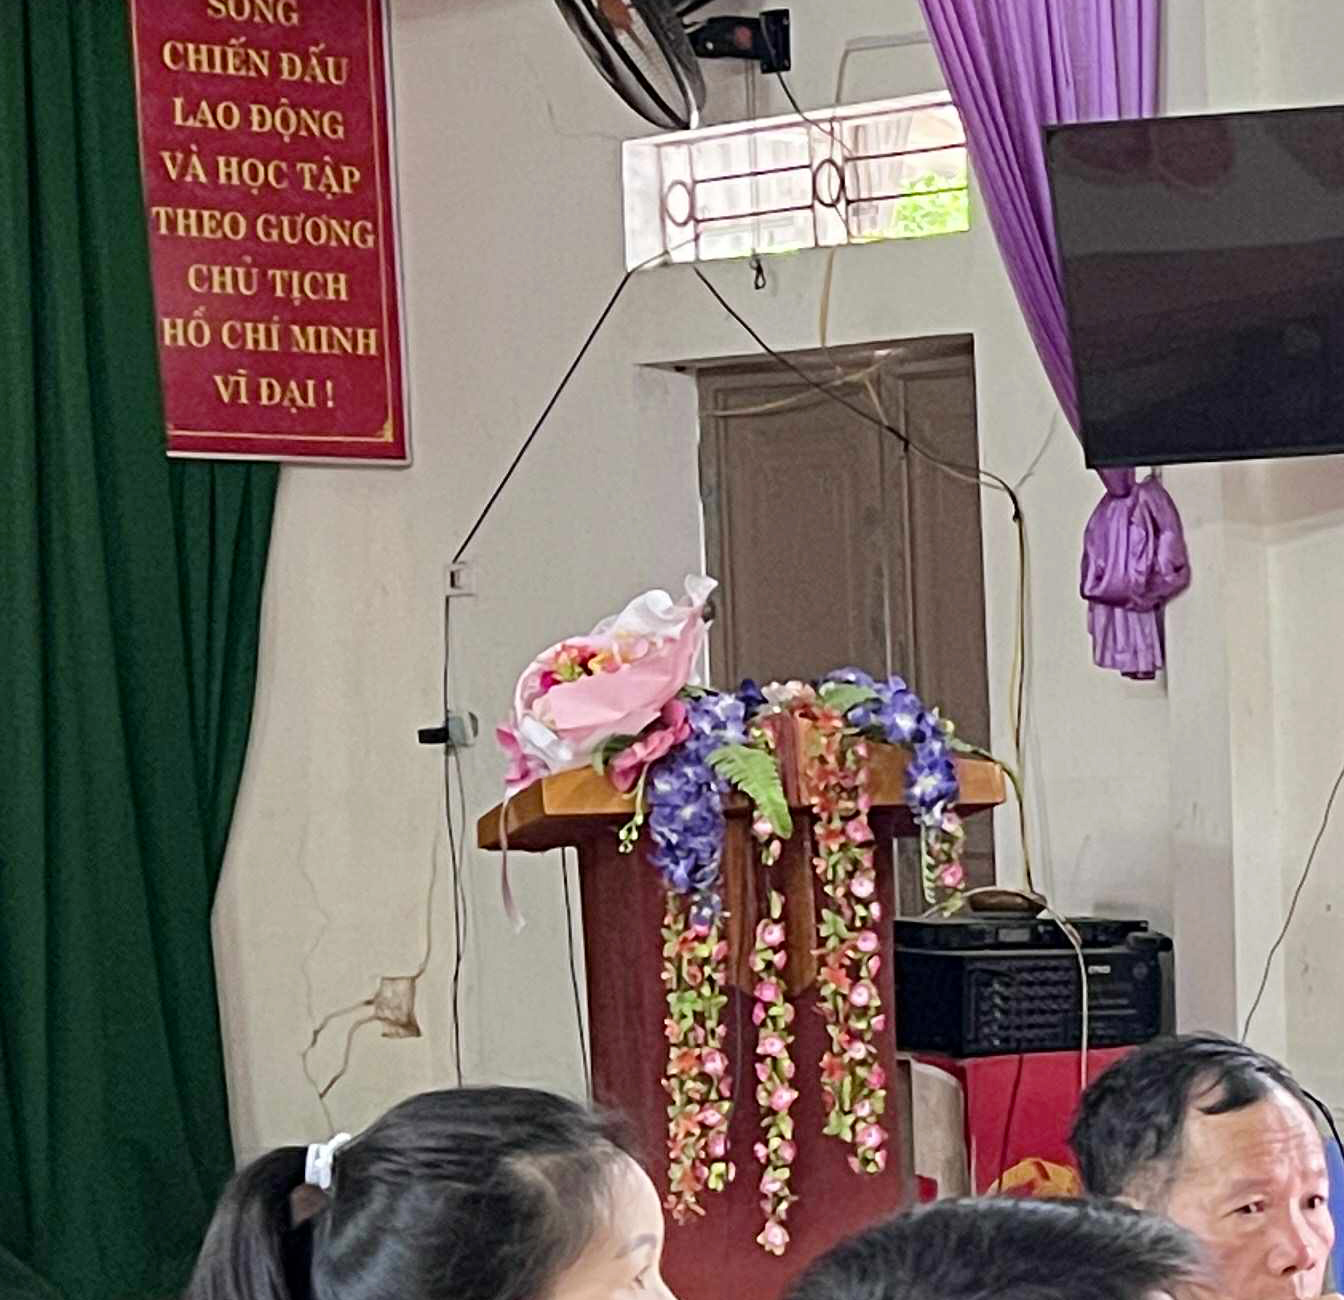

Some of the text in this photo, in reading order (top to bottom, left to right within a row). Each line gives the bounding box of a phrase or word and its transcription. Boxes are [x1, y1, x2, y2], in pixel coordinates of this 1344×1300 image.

[162, 36, 348, 85] CHIẾN ĐẤU
[173, 97, 345, 143] LAO ĐỘNG
[160, 144, 361, 200] VÀ HỌC TẬP
[151, 206, 375, 248] THEO GƯƠNG
[187, 255, 349, 306] CHỦ TỊCH
[161, 305, 379, 357] HỒ CHÍ MINH
[213, 368, 249, 404] VĨ
[258, 377, 316, 414] ĐẠI
